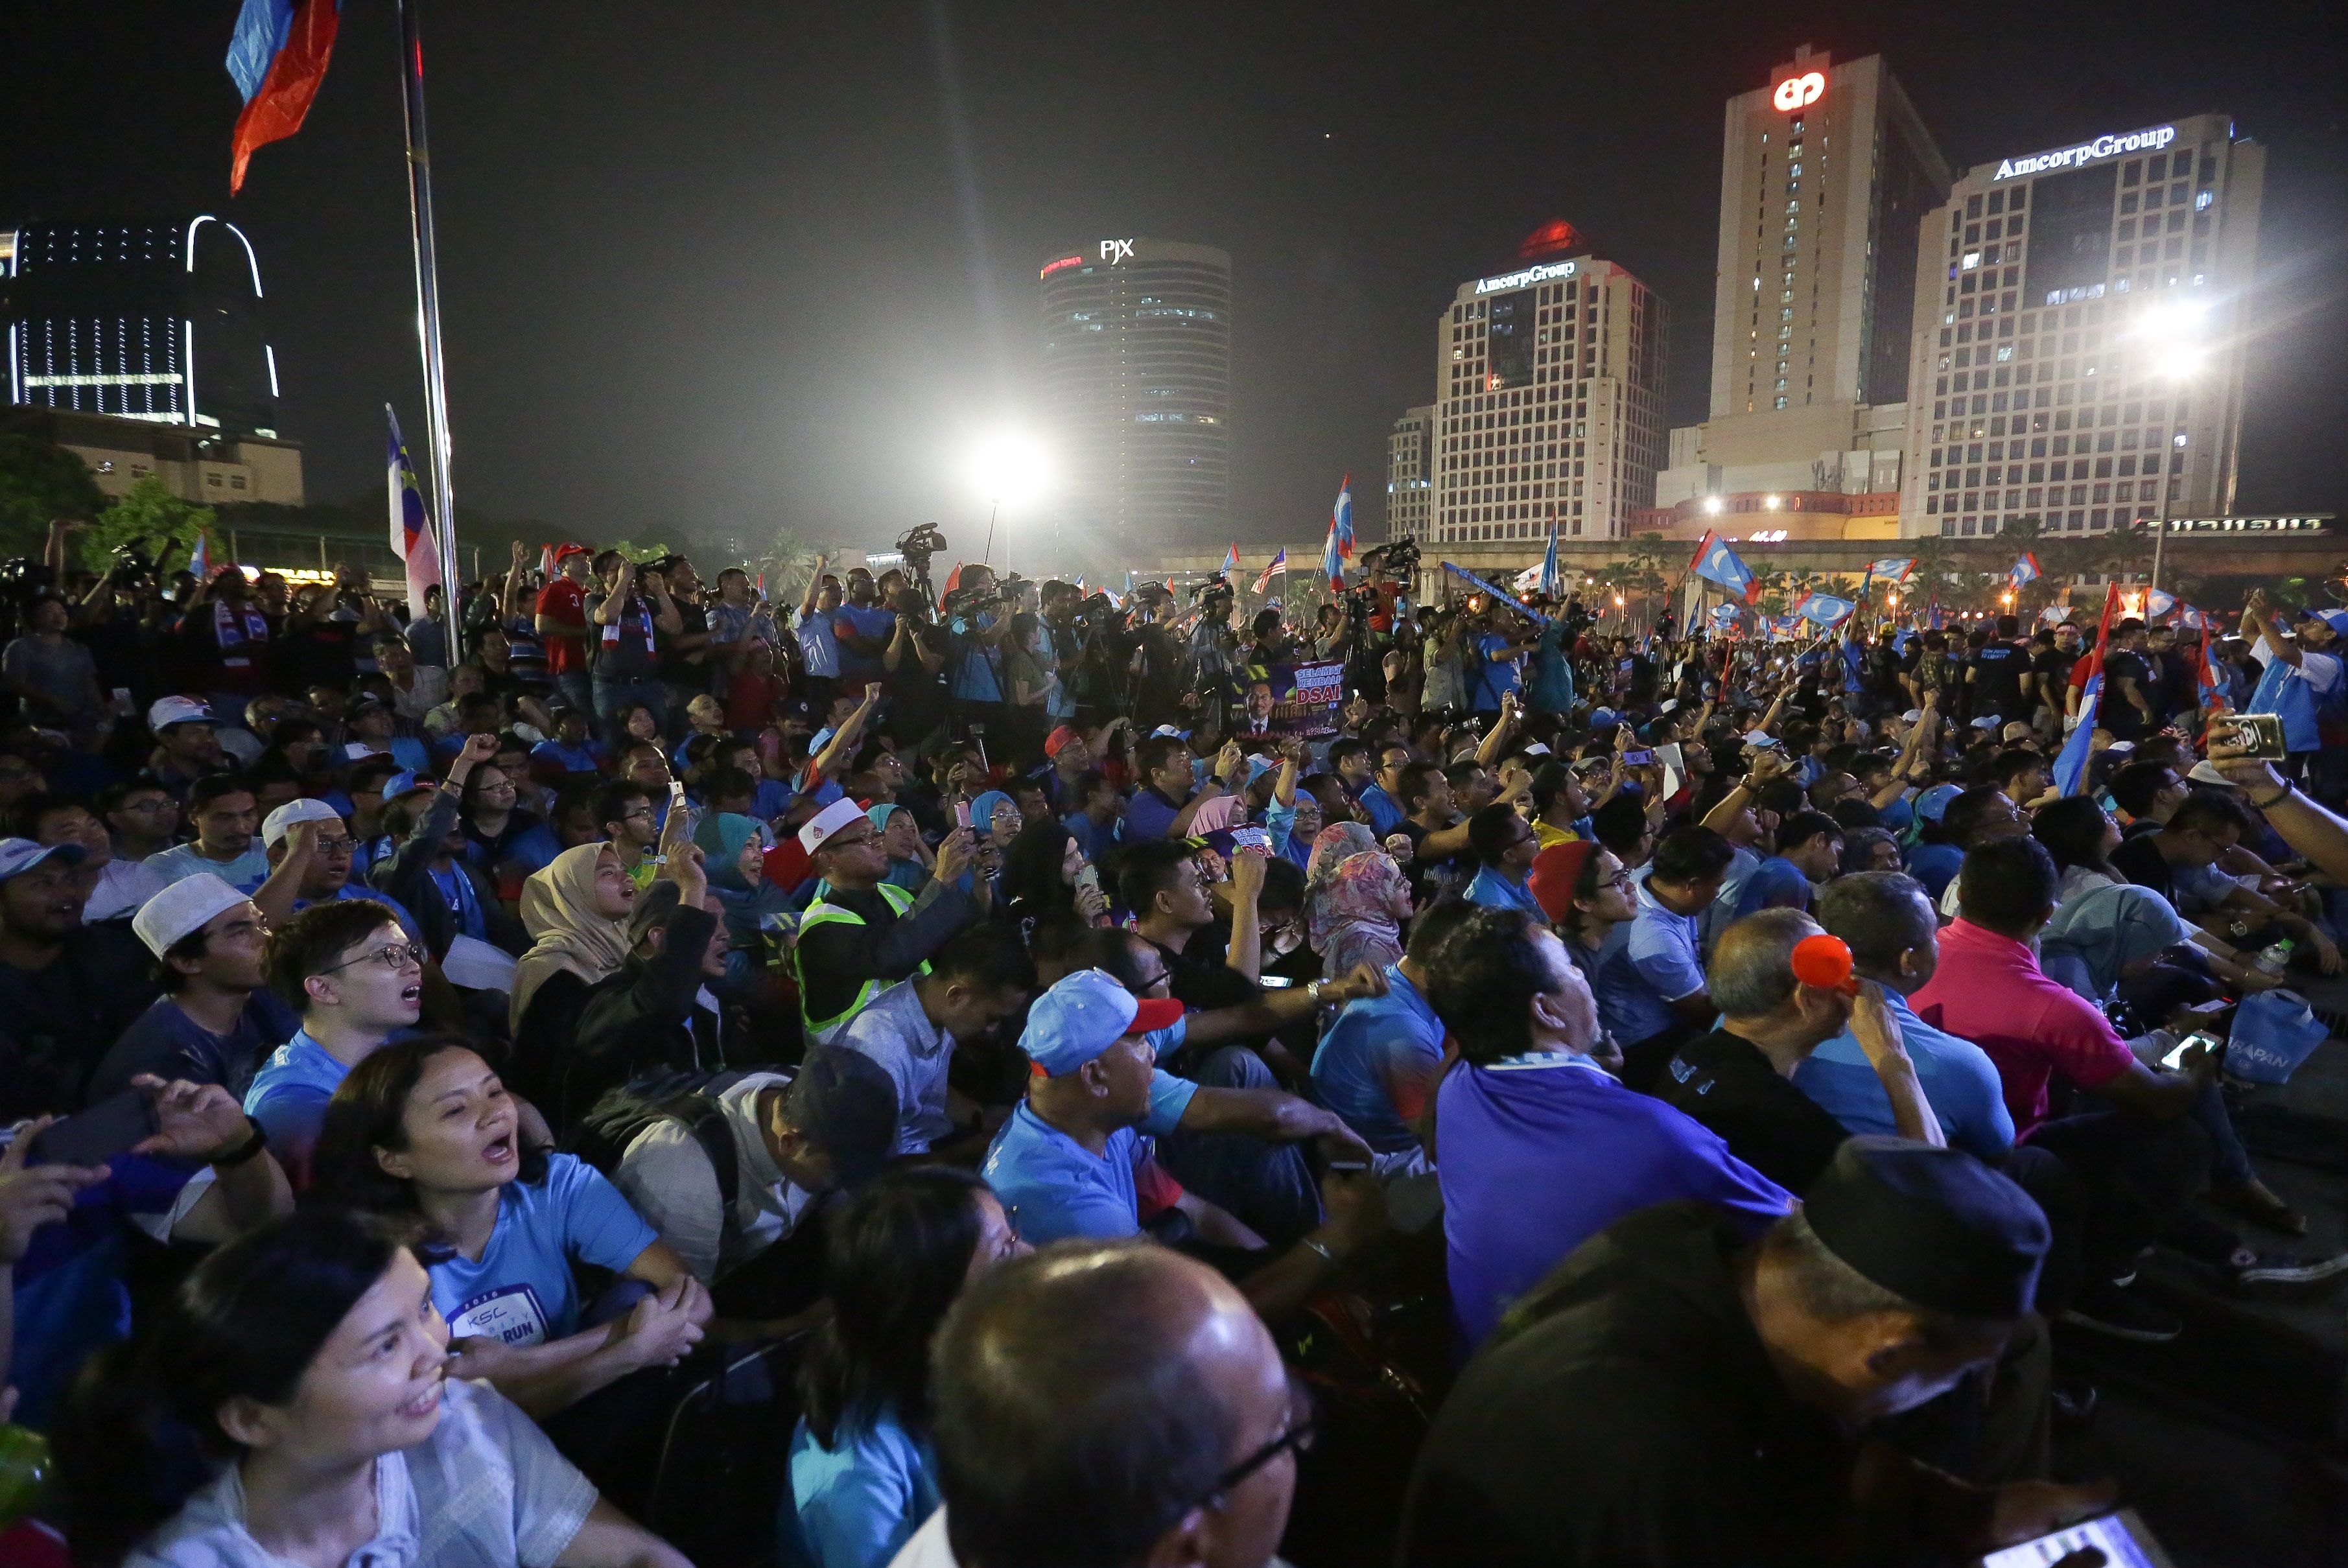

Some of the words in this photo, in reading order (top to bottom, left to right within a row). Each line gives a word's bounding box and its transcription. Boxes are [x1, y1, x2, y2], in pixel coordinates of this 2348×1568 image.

[1993, 126, 2174, 181] AmcorpGroup
[1100, 238, 1134, 264] PJX
[1475, 261, 1575, 294] AmcorpGroup
[1297, 664, 1344, 678] SELAMAT
[1297, 675, 1343, 688] KEMBALI
[1297, 685, 1342, 705] DSAI
[1238, 835, 1263, 845] KEMB
[467, 1307, 508, 1329] KSC
[503, 1321, 535, 1344] RUN
